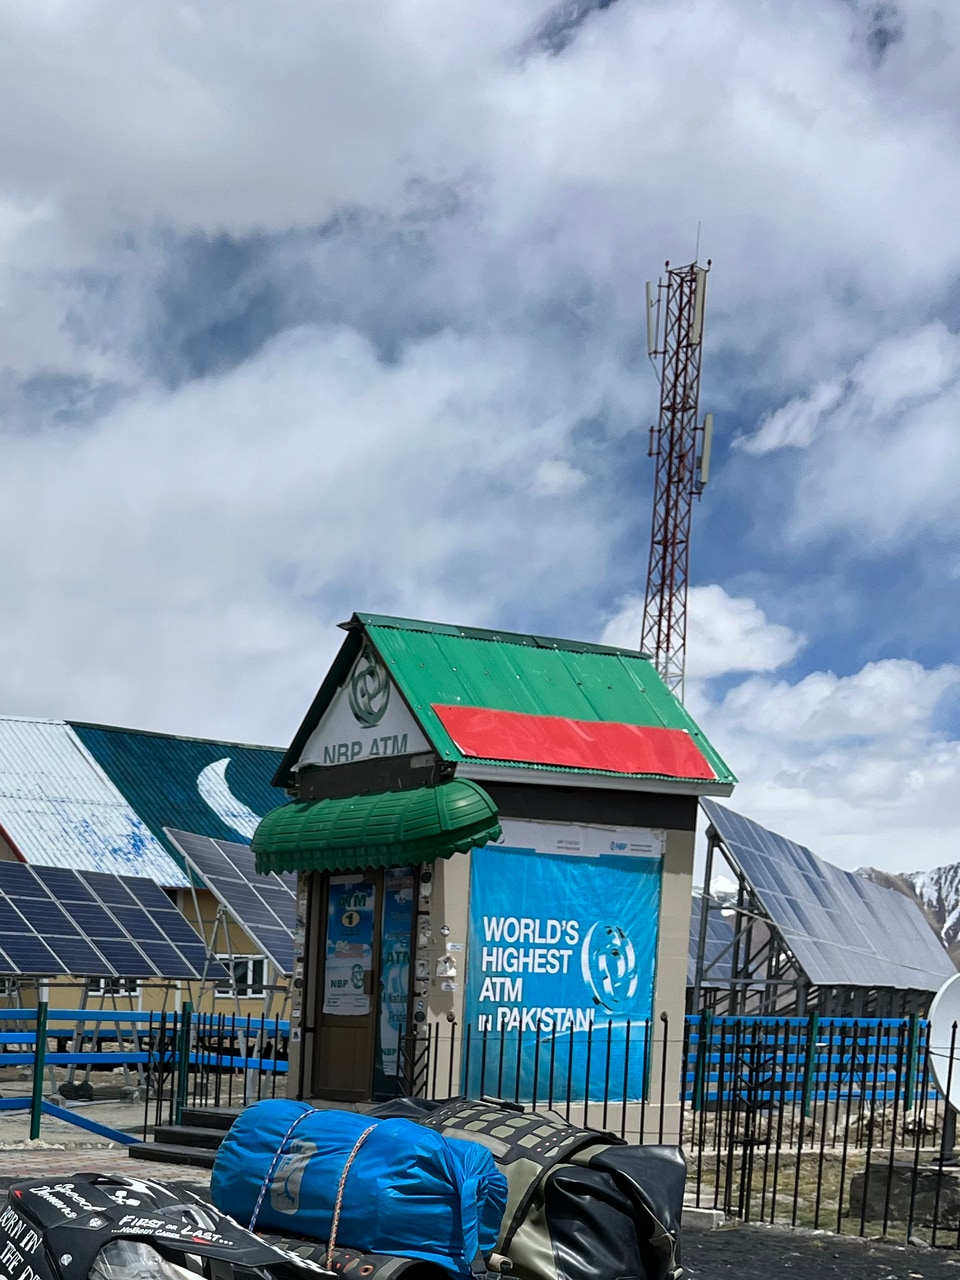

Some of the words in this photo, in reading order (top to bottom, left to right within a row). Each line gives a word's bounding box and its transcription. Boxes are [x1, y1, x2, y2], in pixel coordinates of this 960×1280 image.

[323, 740, 362, 763] NBP
[369, 733, 408, 756] ATM
[338, 893, 367, 908] ATM
[345, 911, 355, 926] 1
[483, 916, 580, 945] WORLD'S
[481, 946, 573, 974] HIGHEST
[330, 979, 349, 988] NBP
[479, 977, 523, 1002] ATM
[478, 1014, 492, 1031] IN
[0, 1205, 27, 1239] BORN
[19, 1229, 43, 1254] IN
[118, 1215, 165, 1230] FIRST
[0, 1240, 24, 1275] THE
